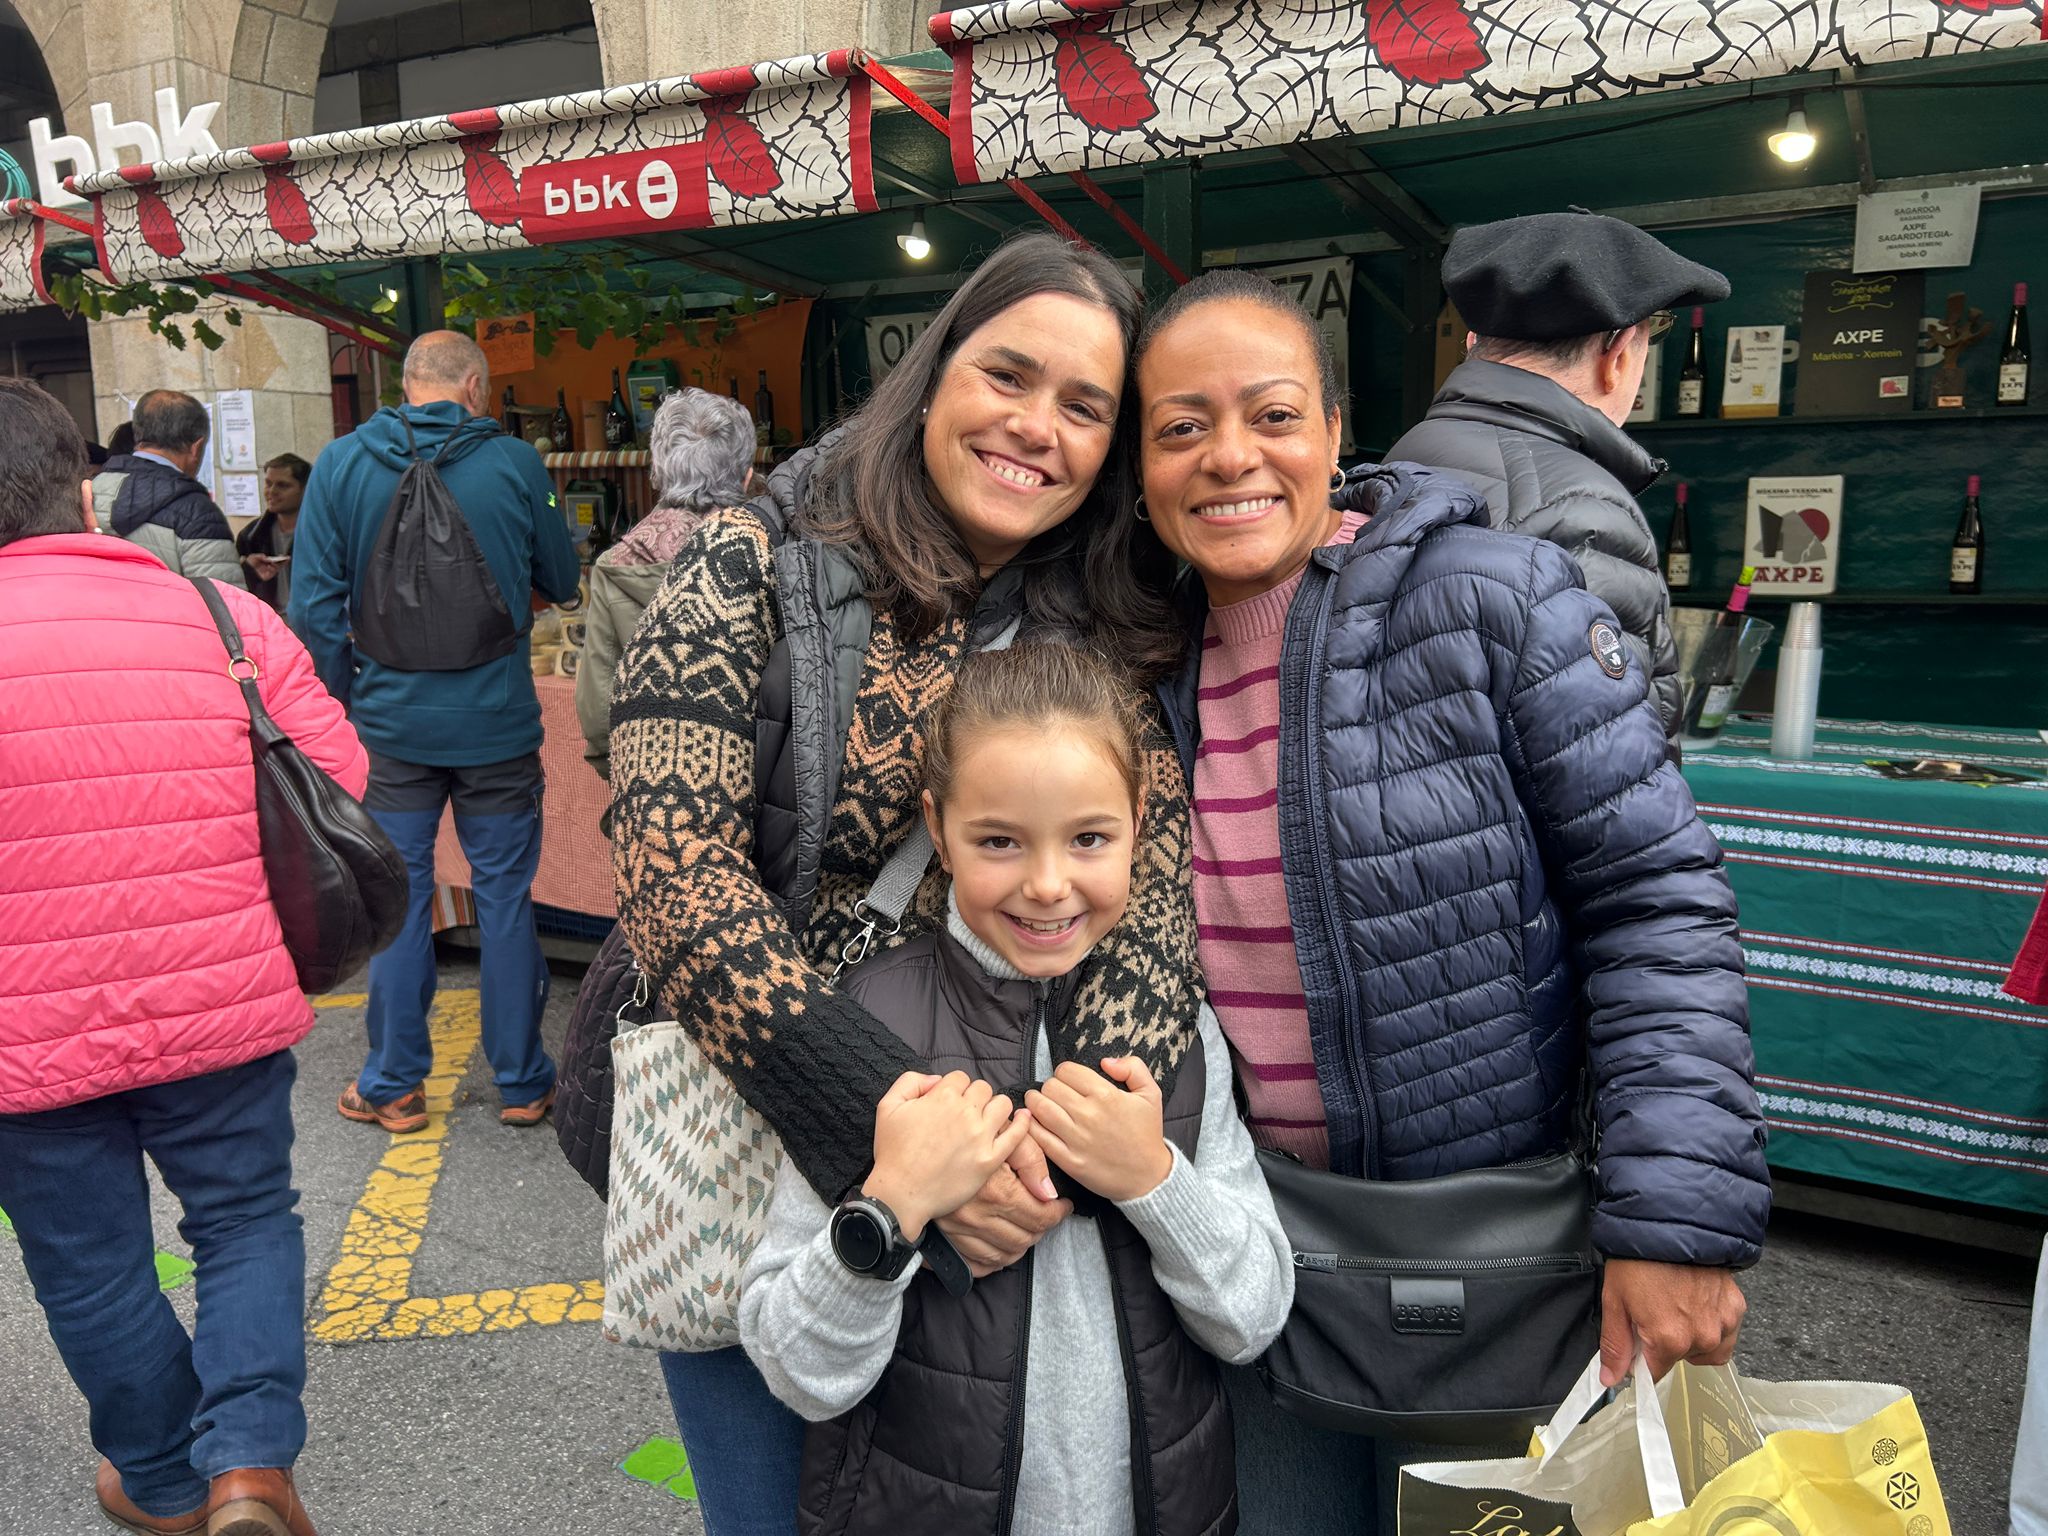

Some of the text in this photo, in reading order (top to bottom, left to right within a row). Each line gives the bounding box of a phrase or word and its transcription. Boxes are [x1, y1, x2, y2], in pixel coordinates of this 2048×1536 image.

[28, 87, 221, 207] bbk
[544, 174, 631, 216] bbk
[1894, 205, 1941, 216] SAGARDOA
[1902, 223, 1927, 231] AXPE
[1833, 329, 1884, 345] AXPE
[1812, 351, 1853, 361] Markina
[1863, 349, 1903, 360] Xemein
[1754, 566, 1824, 583] AXPE
